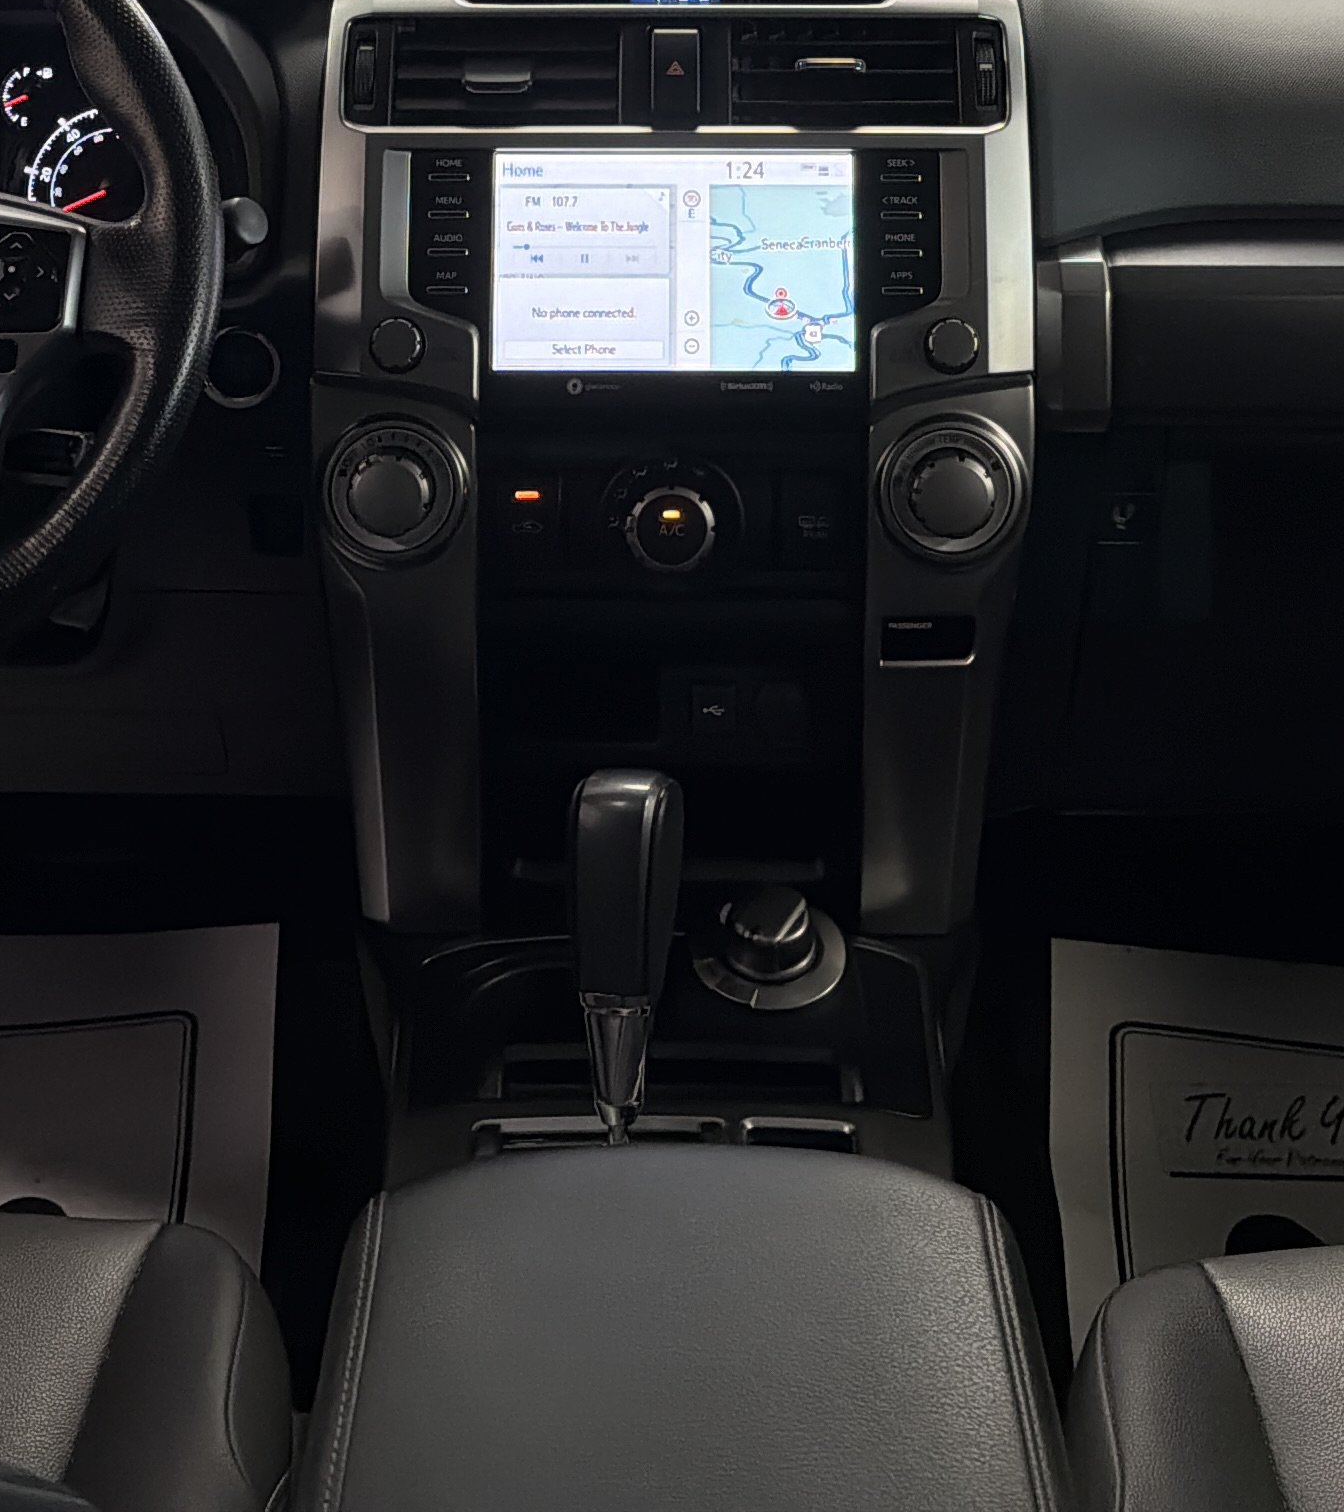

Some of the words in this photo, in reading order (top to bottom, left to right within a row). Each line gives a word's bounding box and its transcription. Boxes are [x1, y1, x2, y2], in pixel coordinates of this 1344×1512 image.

[20, 117, 28, 127] E
[66, 128, 81, 143] 40
[435, 159, 463, 167] HOME
[40, 167, 53, 183] 20
[502, 161, 544, 178] Home
[726, 161, 765, 180] 1:24
[435, 196, 463, 205] MENU
[524, 196, 542, 207] FM
[552, 196, 579, 208] 107.7
[564, 220, 599, 233] Welcome
[600, 220, 609, 232] To
[610, 220, 625, 232] The
[433, 233, 464, 242] AUDIO
[884, 233, 917, 242] PHONE
[761, 238, 802, 251] Seneca
[435, 271, 458, 280] MAP
[890, 271, 914, 279] APPS
[531, 307, 548, 319] No
[549, 308, 581, 320] phone
[582, 306, 637, 319] connected.
[552, 343, 582, 355] Select
[584, 343, 616, 355] Phone
[659, 524, 686, 537] A/C
[1184, 1092, 1306, 1143] Thank
